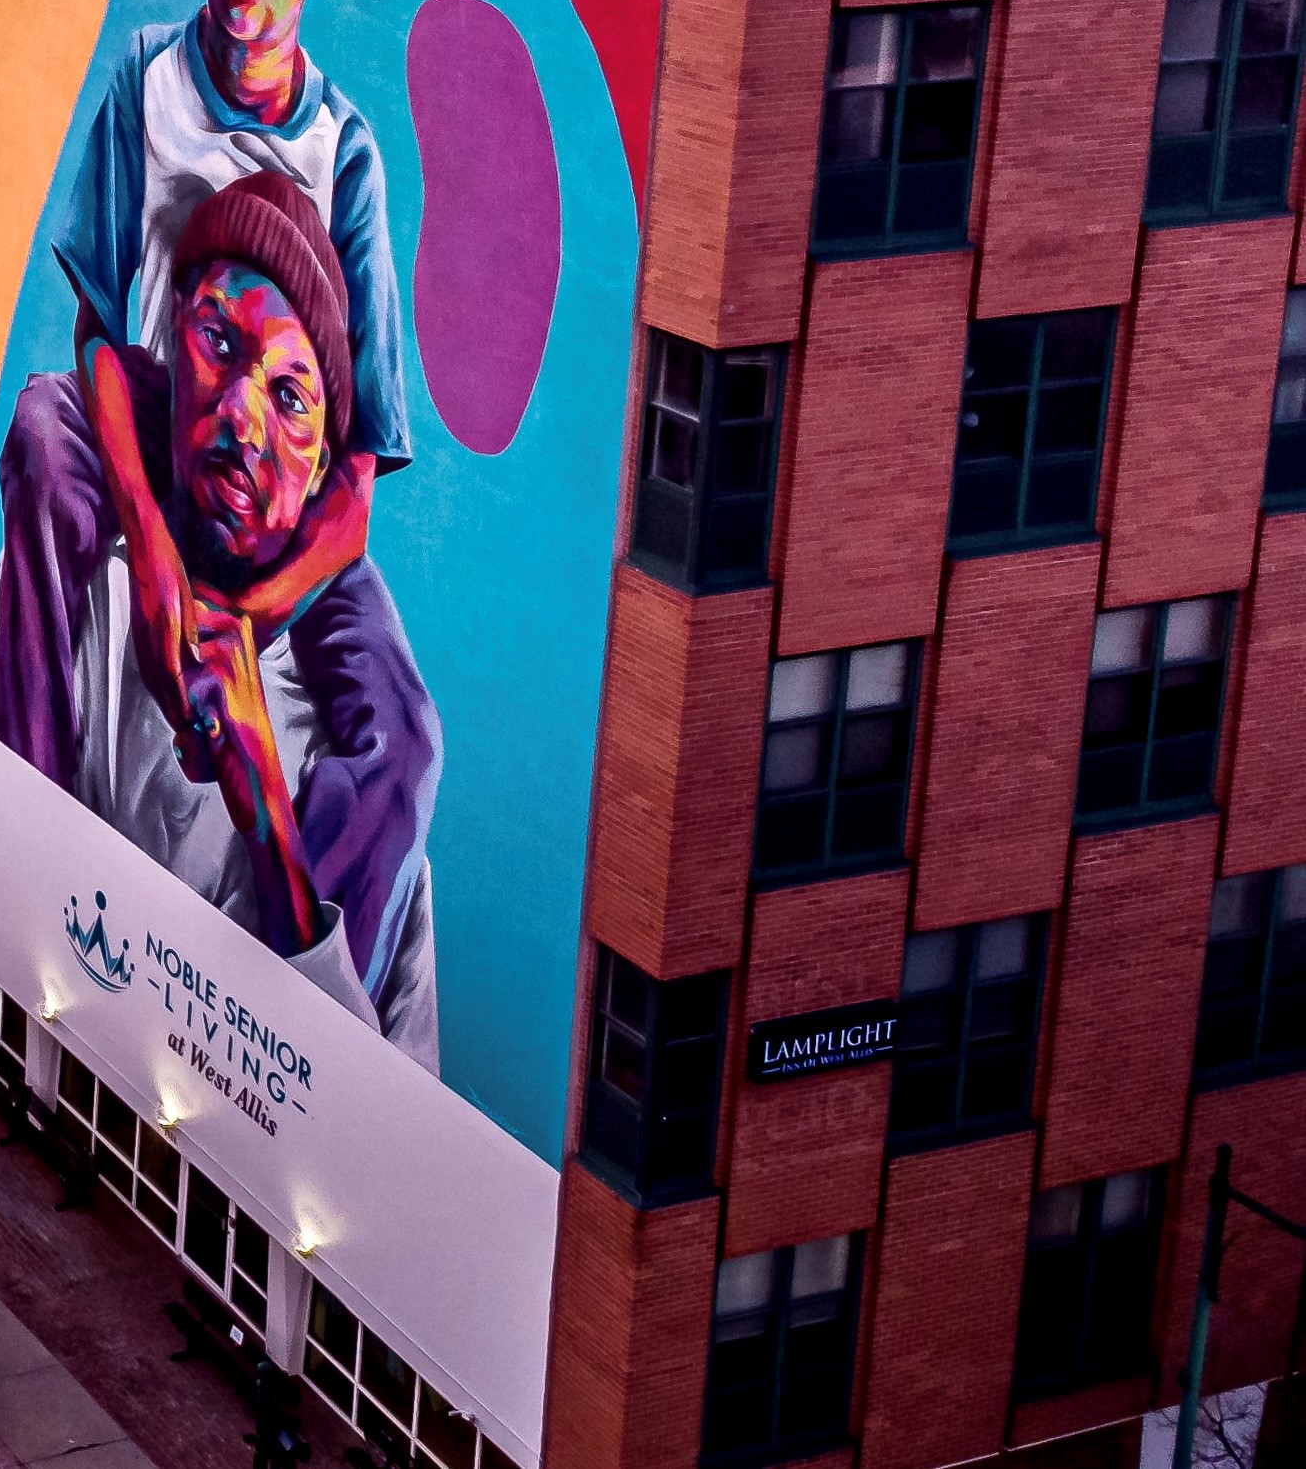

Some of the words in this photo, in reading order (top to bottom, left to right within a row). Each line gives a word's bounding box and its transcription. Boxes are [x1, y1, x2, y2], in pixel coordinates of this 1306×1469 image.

[145, 930, 218, 1012] NOBLE
[223, 996, 312, 1091] SENIOR
[764, 1018, 897, 1063] LAMPLIGHT
[167, 1032, 185, 1057] at
[190, 1041, 232, 1098] West
[234, 1086, 278, 1138] Allis
